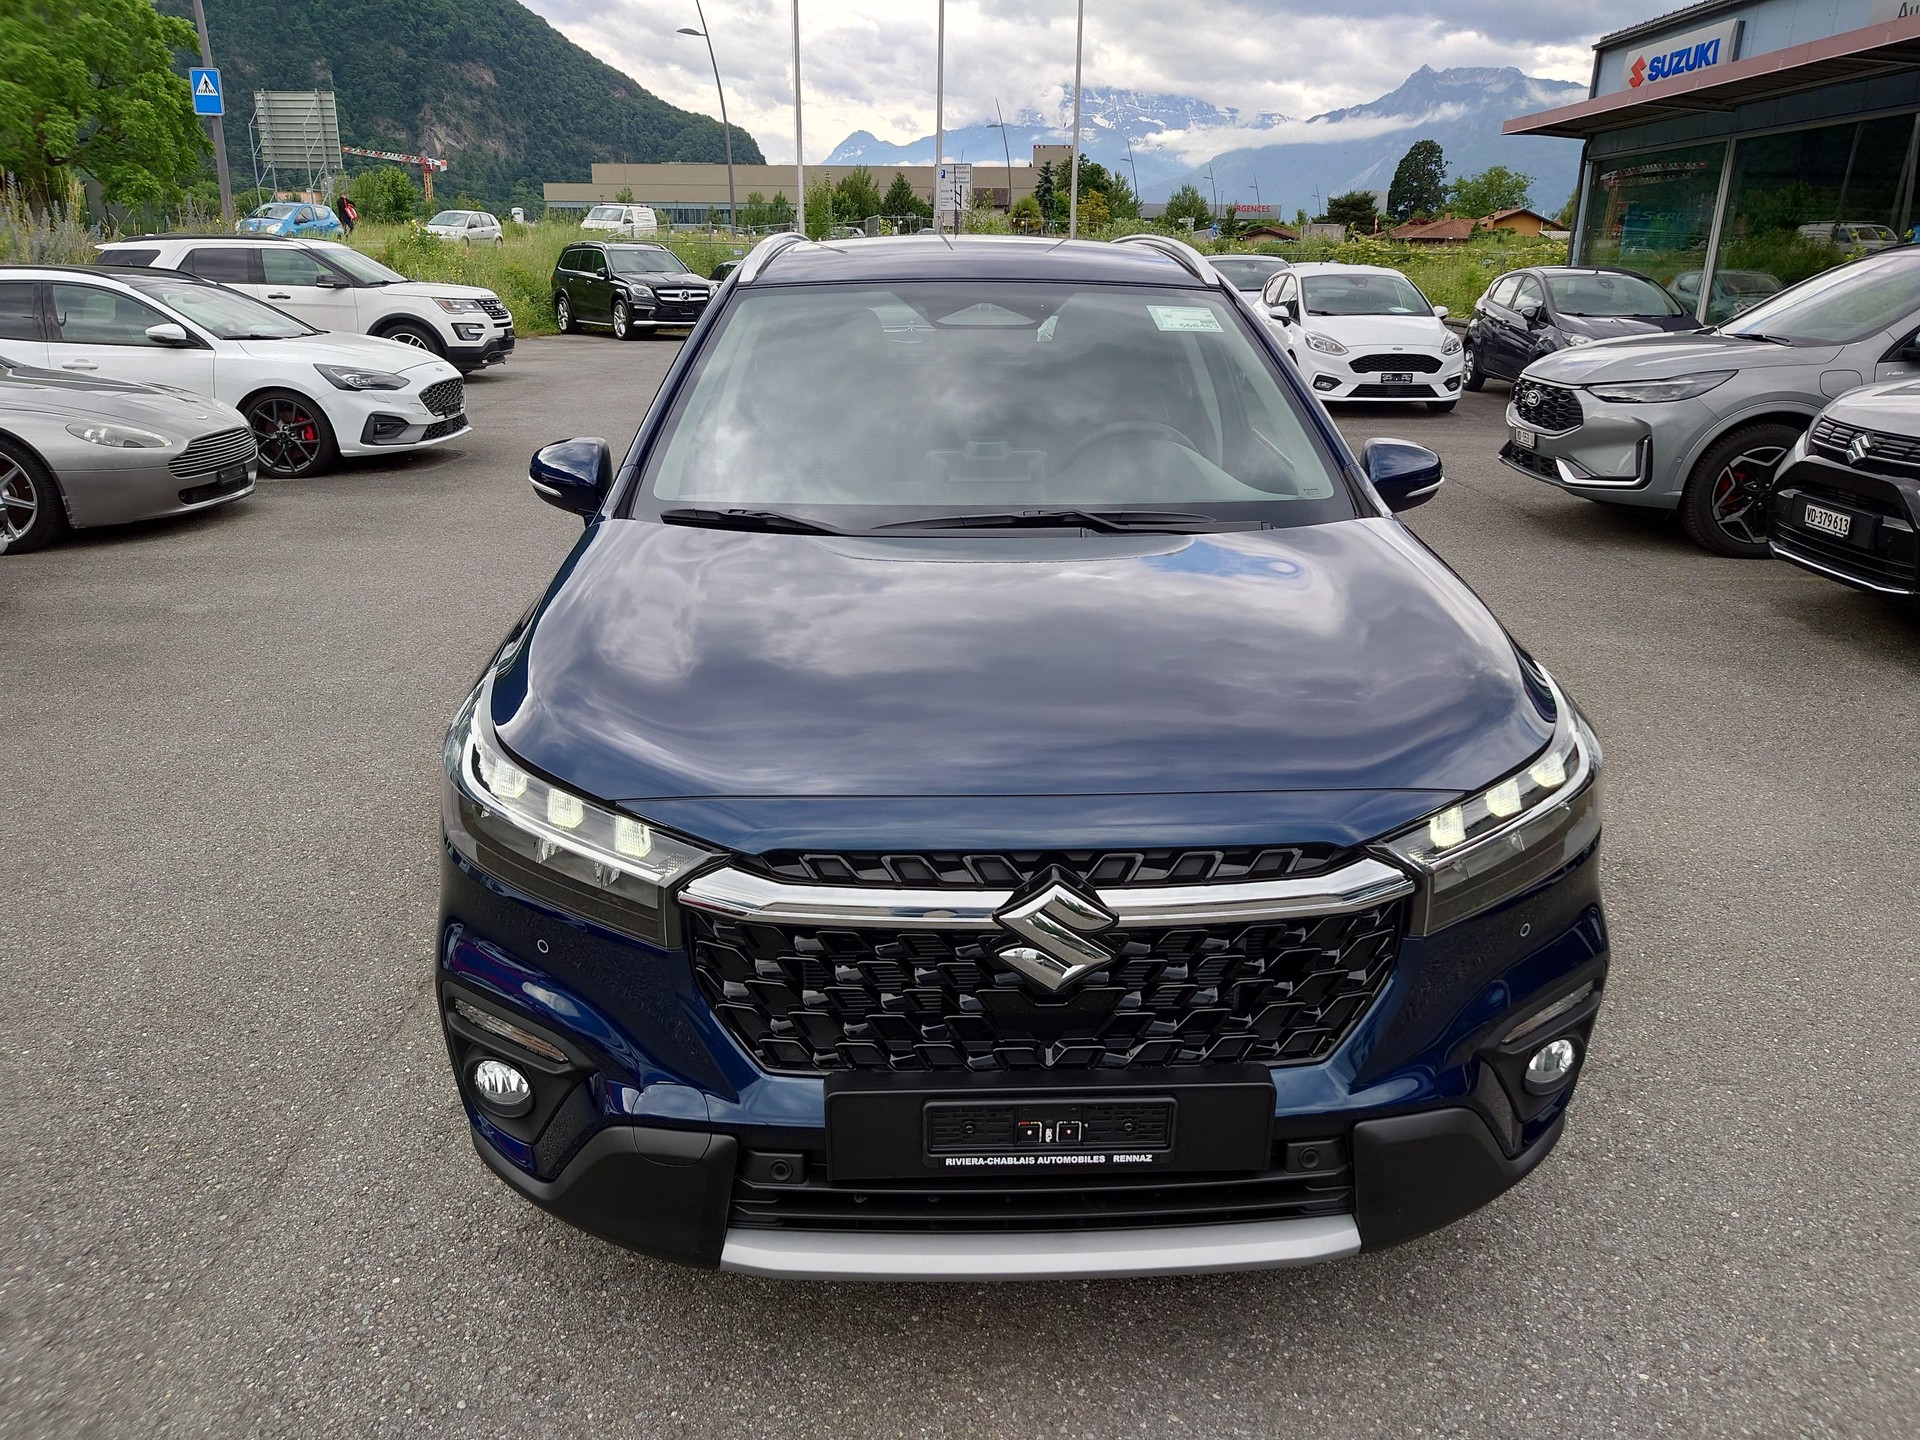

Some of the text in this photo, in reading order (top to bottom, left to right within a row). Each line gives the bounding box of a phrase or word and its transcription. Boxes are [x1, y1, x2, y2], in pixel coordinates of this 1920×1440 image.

[1647, 38, 1721, 82] SUZUKI
[1235, 205, 1271, 213] RGENCES
[945, 1154, 1153, 1166] RIVIERA-CHABLAIS AUTOMOBILES RENNAZ
